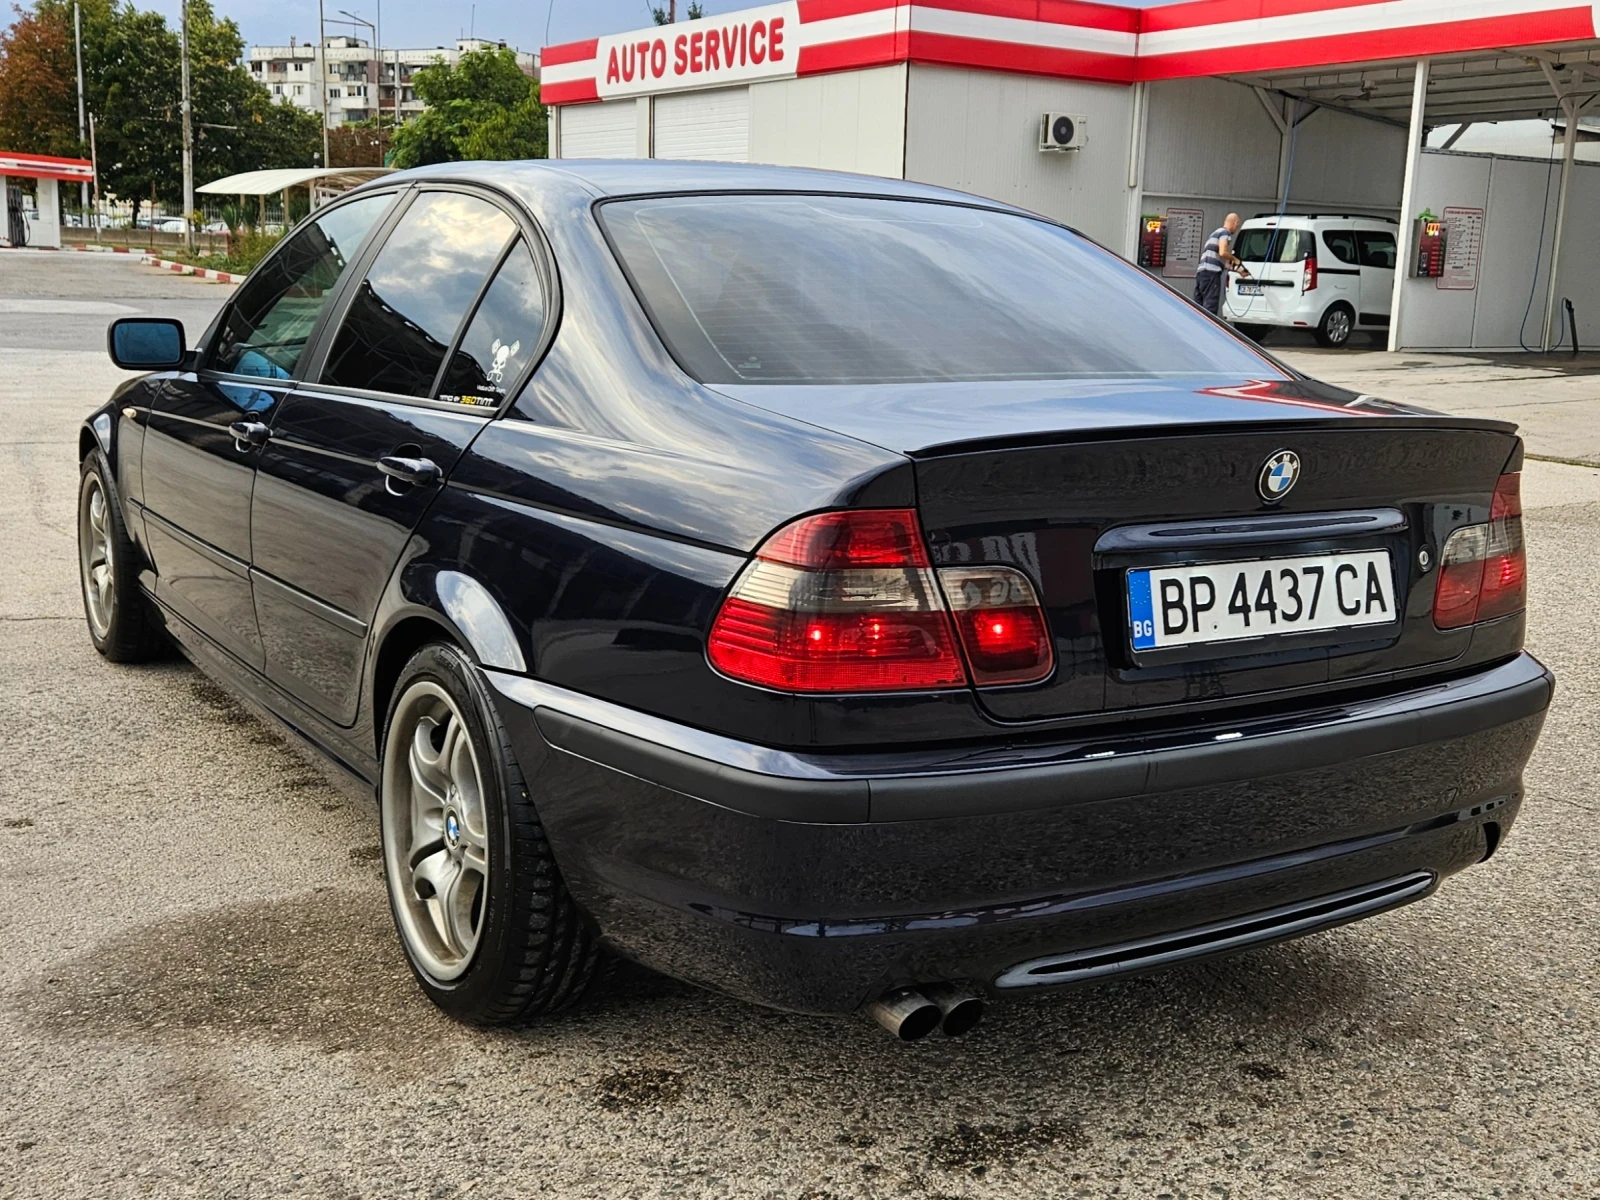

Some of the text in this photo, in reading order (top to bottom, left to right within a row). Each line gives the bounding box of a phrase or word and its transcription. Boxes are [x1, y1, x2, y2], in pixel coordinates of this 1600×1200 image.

[606, 17, 784, 85] AUTO SERVICE
[1268, 454, 1298, 470] BMW
[1160, 561, 1387, 635] BP 4437 CA
[1133, 620, 1152, 638] BG
